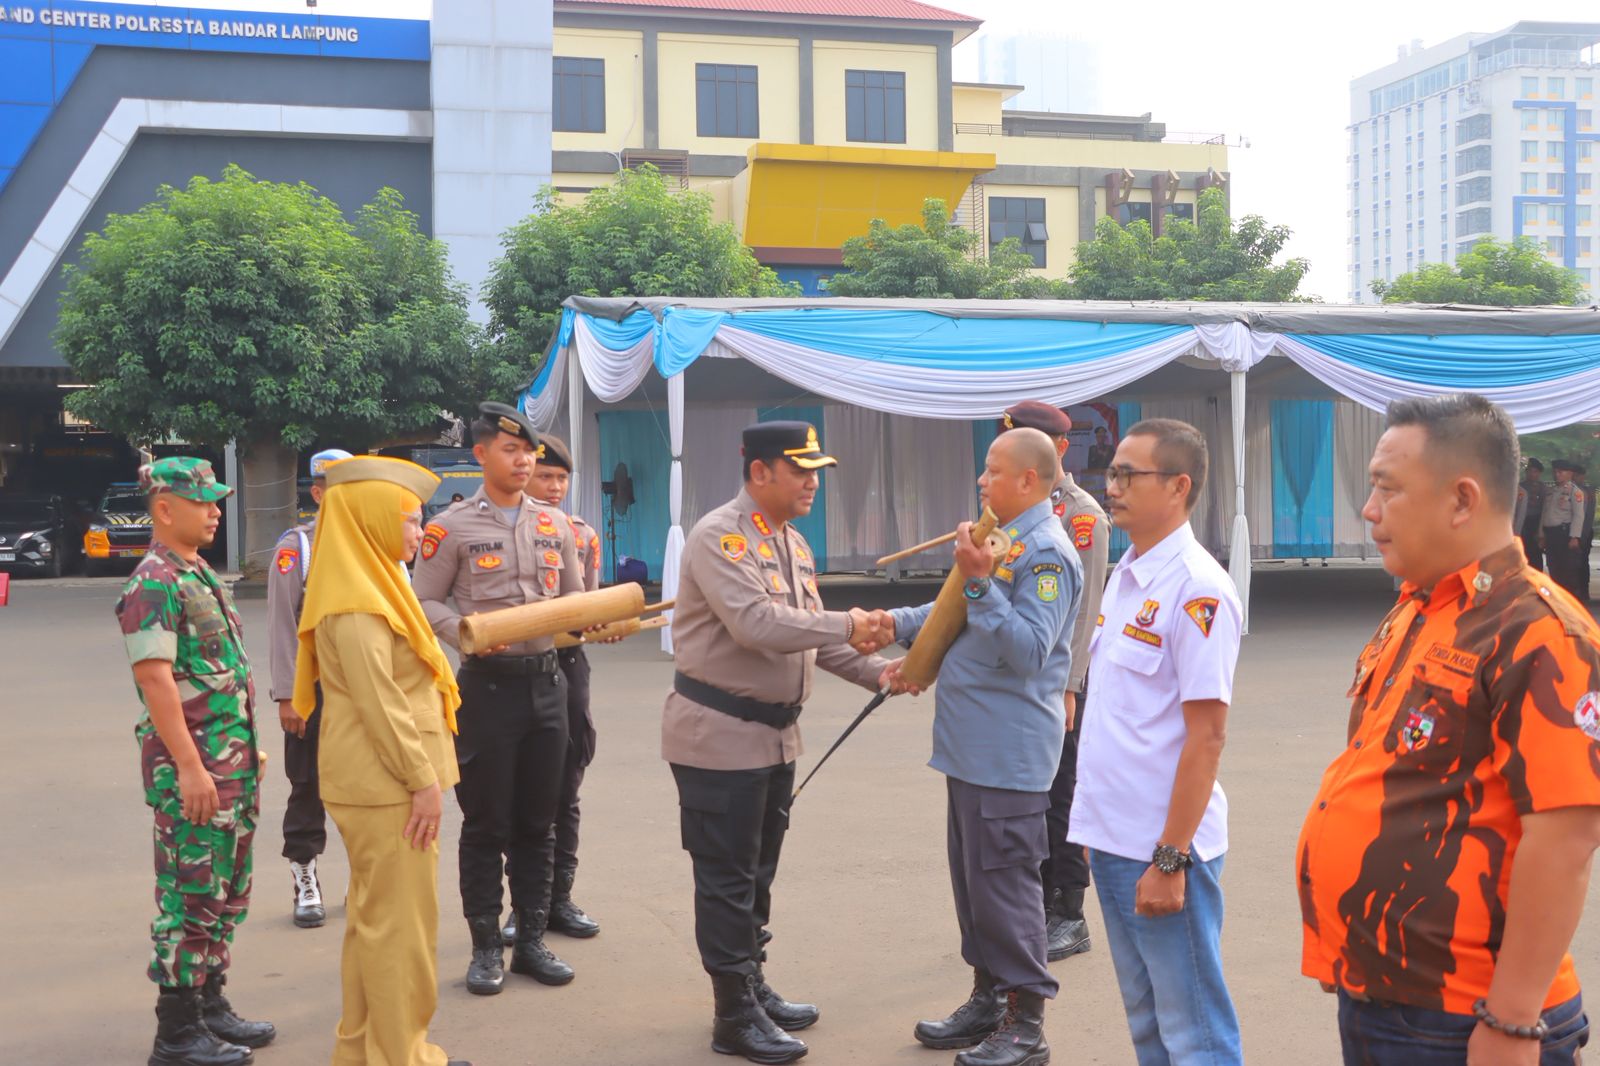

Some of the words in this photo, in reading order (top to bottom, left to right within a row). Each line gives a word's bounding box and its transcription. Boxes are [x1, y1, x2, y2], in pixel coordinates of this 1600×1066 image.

[40, 9, 112, 29] CENTER
[115, 14, 206, 35] POLRESTA
[209, 20, 278, 39] BANDAR
[281, 24, 359, 43] LAMPUNG
